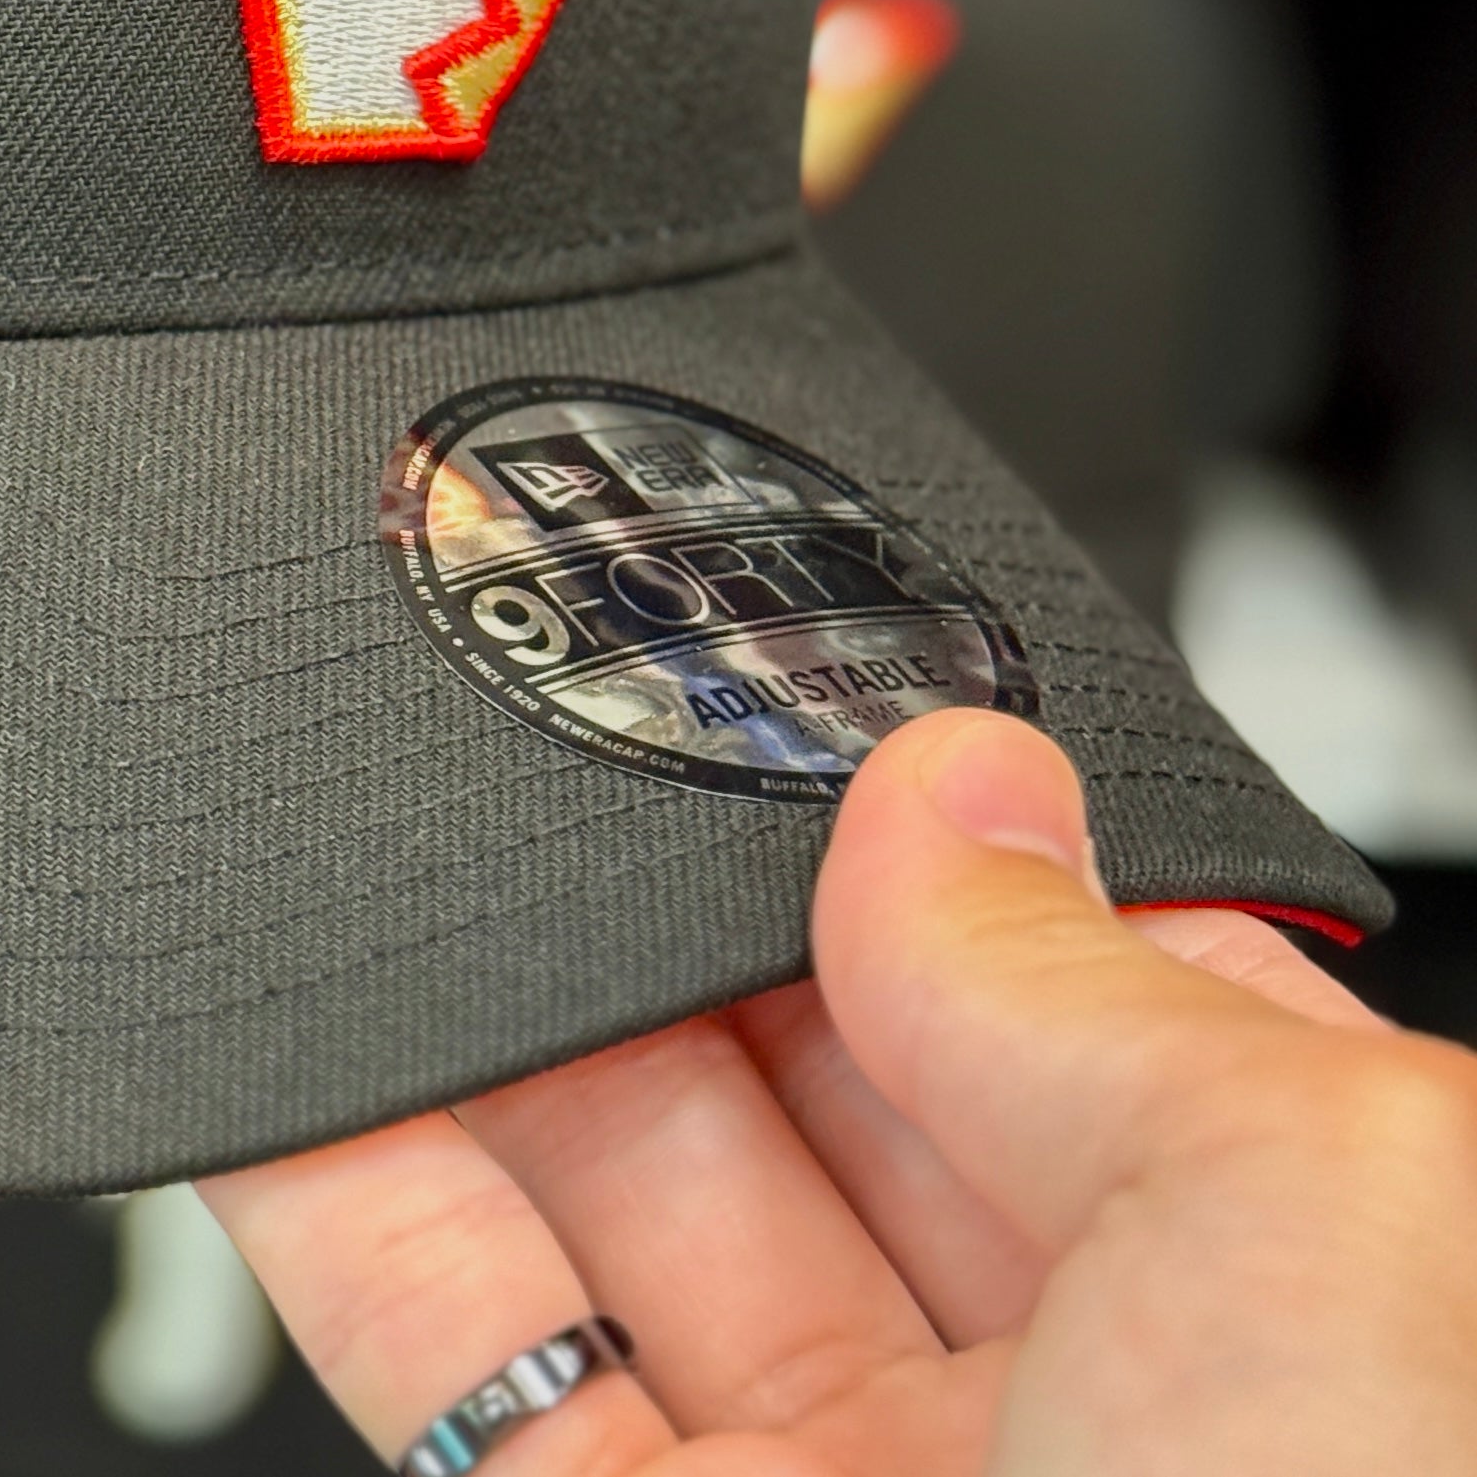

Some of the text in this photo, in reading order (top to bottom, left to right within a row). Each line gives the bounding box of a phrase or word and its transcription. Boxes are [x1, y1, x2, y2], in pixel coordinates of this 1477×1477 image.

[611, 441, 697, 471] NEW
[635, 466, 727, 493] ERA
[470, 528, 915, 666] 9FORTY
[427, 608, 453, 634] USA
[464, 651, 503, 686] SINCE
[503, 683, 541, 713] 1920
[548, 712, 687, 775] NEWERACAP.COM
[688, 651, 950, 729] ADJUSTABLE
